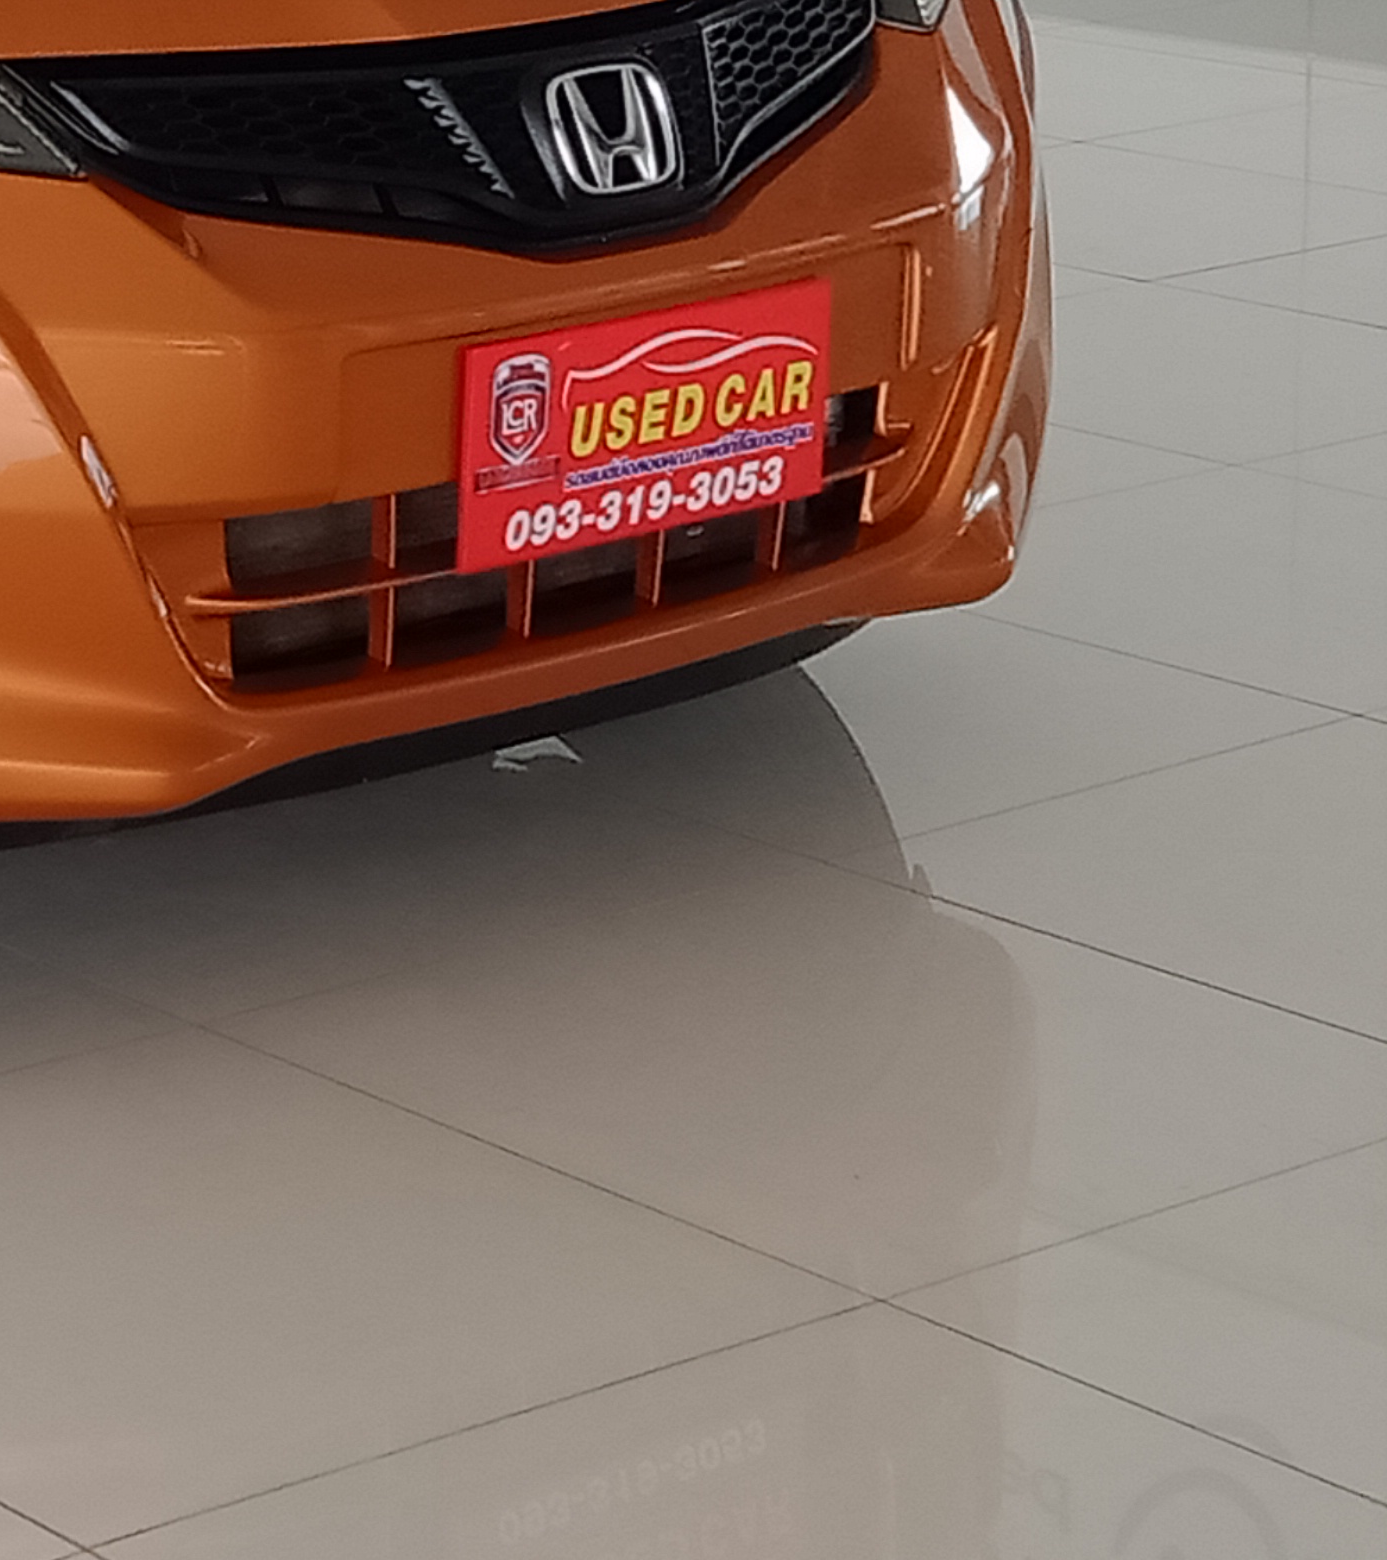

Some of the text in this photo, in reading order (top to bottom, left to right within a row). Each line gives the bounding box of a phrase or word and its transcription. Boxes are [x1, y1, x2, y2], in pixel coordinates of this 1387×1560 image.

[570, 360, 813, 458] USED CAR
[505, 456, 784, 551] 093-319-3053
